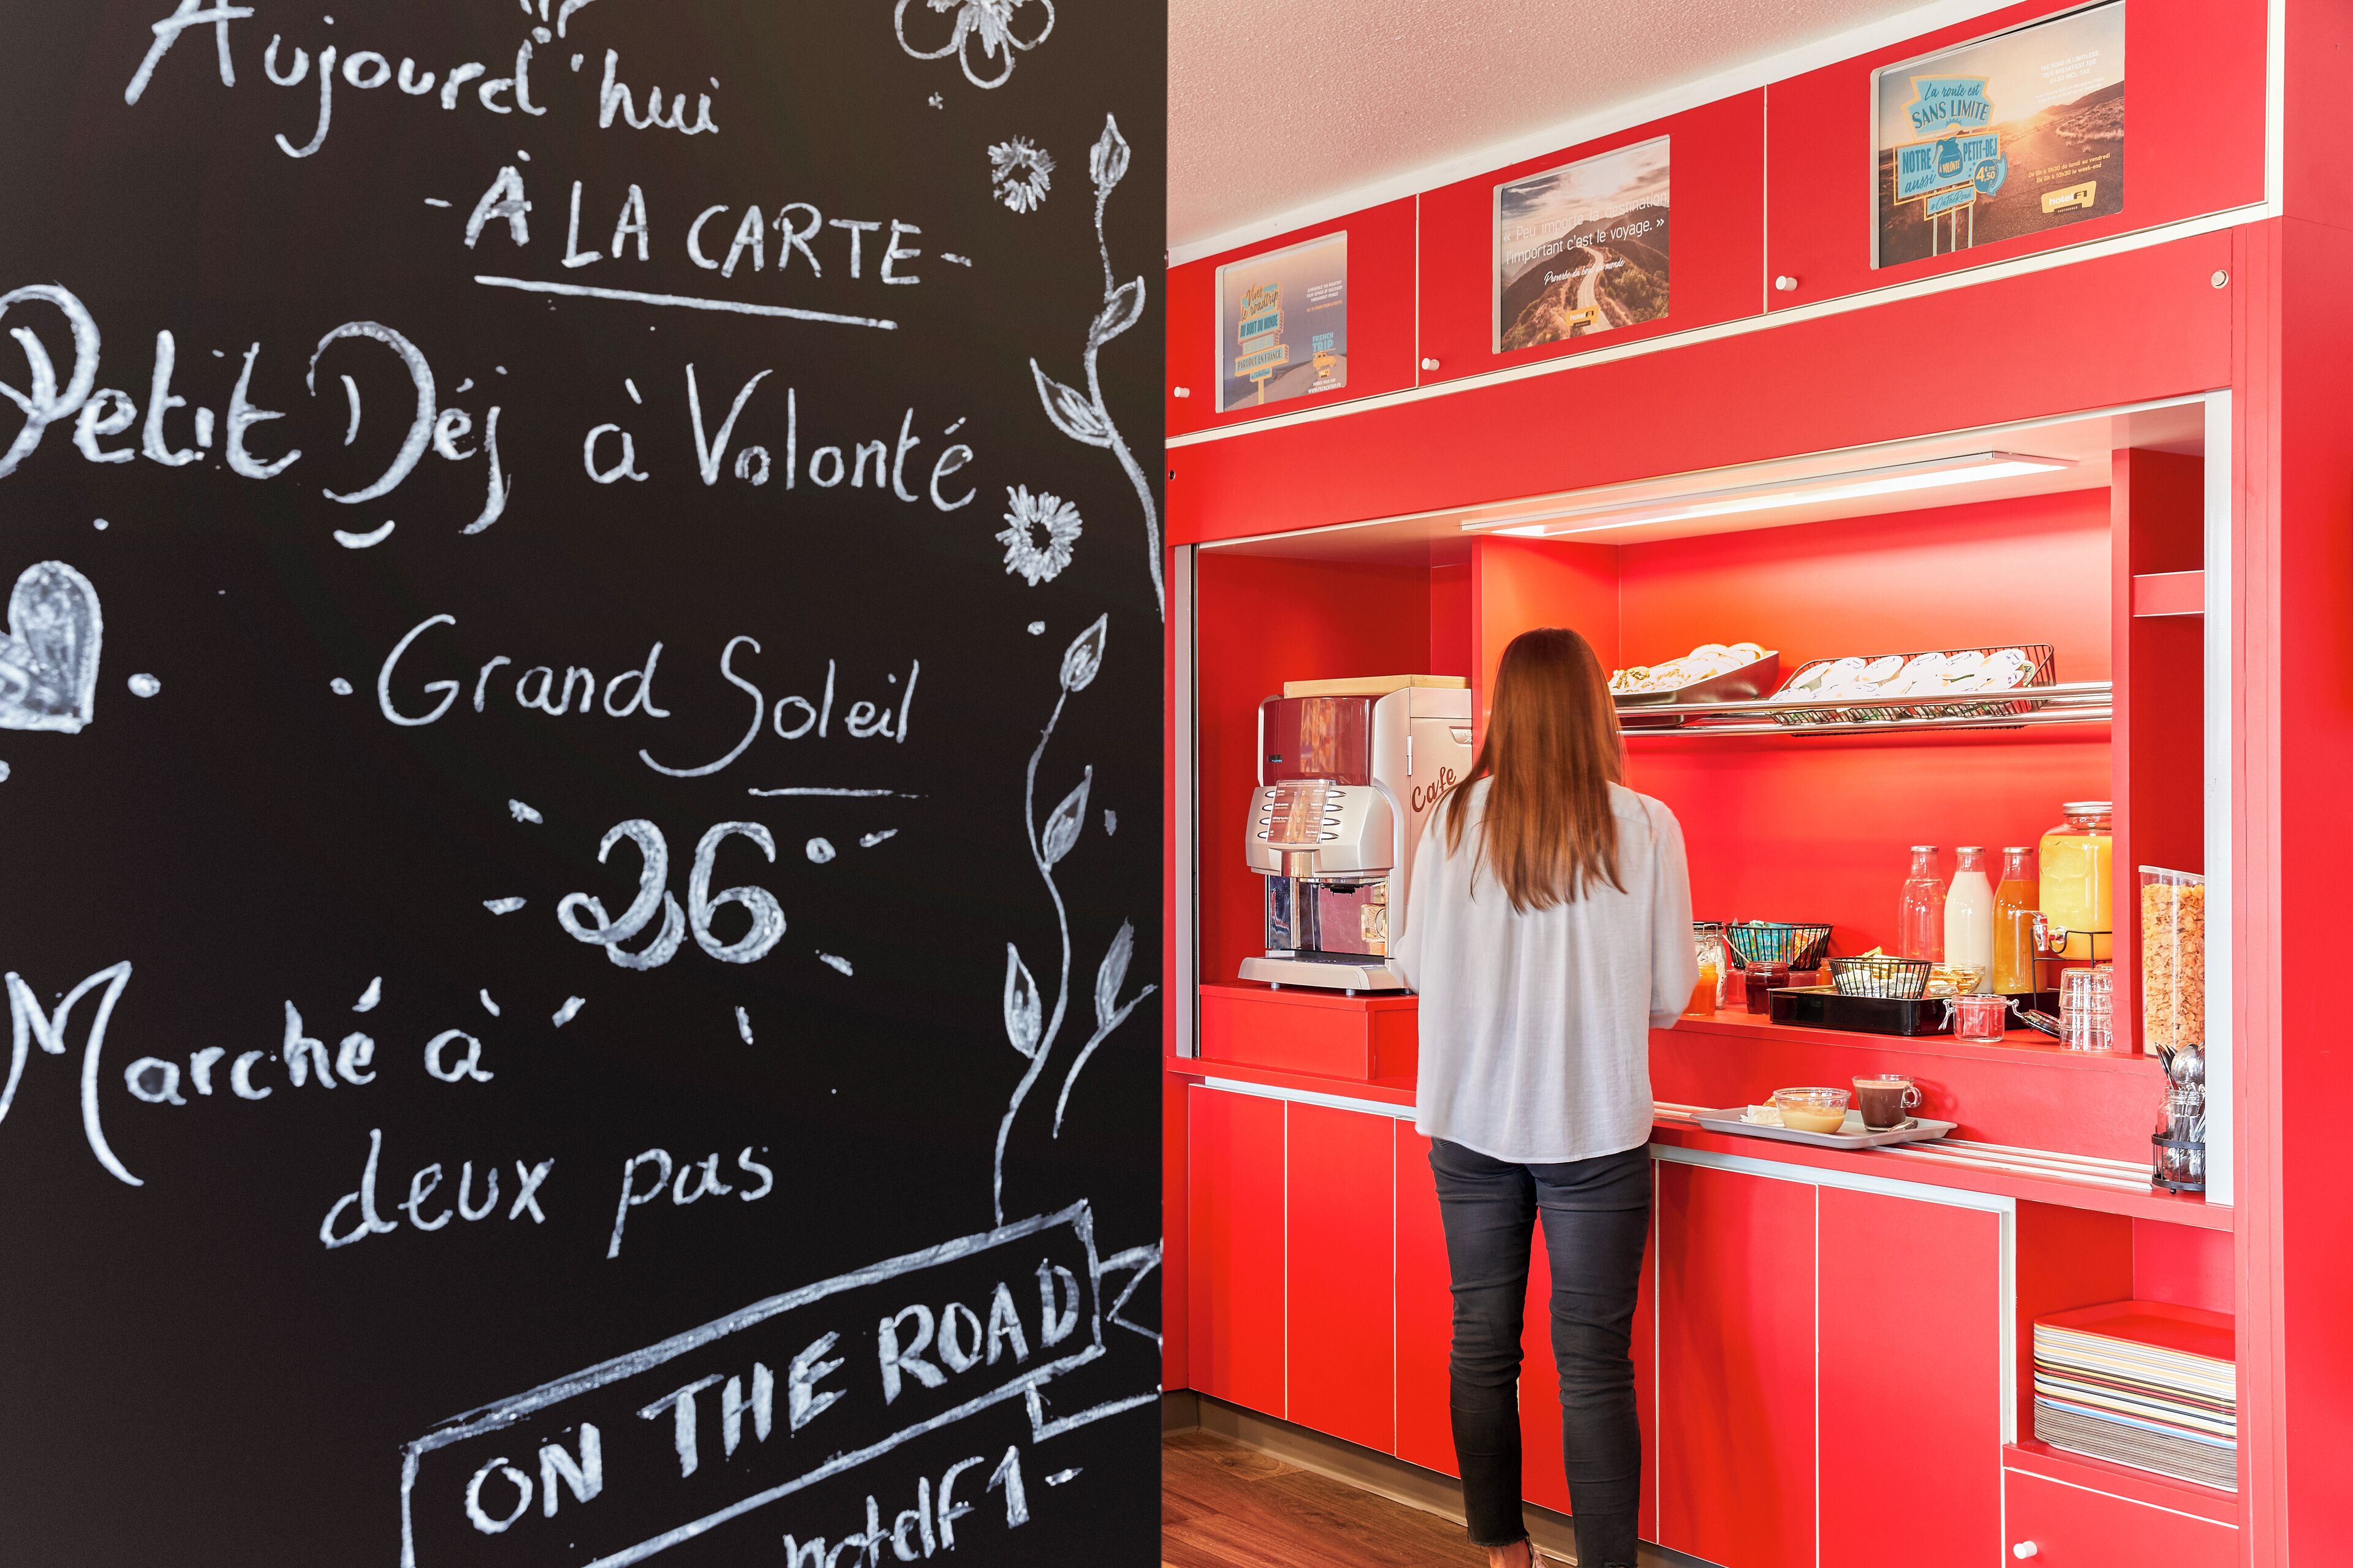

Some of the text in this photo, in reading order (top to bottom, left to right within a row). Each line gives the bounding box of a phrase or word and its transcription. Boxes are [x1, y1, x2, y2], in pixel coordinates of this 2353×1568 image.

[2055, 62, 2085, 75] BREAKFAST
[1924, 83, 1982, 100] La route est
[1912, 100, 1989, 129] SANS LIMITE
[1903, 148, 1931, 174] NOTRE
[2056, 170, 2071, 178] 10h30
[2078, 162, 2102, 173] week-end
[2089, 152, 2110, 162] vendredi
[1904, 170, 1936, 193] aussi
[561, 181, 650, 268] LA
[1516, 225, 1536, 241] Peu
[1542, 213, 1584, 235] importe
[1590, 210, 1599, 223] la
[1506, 240, 1563, 265] l'important
[1567, 232, 1593, 251] c'est
[1597, 230, 1606, 243] le
[1610, 219, 1653, 241] voyage.
[1544, 271, 1571, 286] Proverbe
[1572, 268, 1580, 278] du
[1605, 257, 1626, 270] monde
[1241, 290, 1278, 322] le roadtrip
[1240, 314, 1278, 338] DU BOUT DU MONDE
[1313, 332, 1334, 343] FRENCH
[1238, 349, 1281, 369] PARTOUT EN FRANCE
[1313, 339, 1334, 352] TRIP
[0, 284, 976, 535] Petit Déj à Volonté
[377, 614, 919, 777] Grand Soleil
[0, 960, 500, 1186] Marché à
[319, 1128, 775, 1259] deux pas
[464, 1258, 1080, 1534] ON THE ROAD
